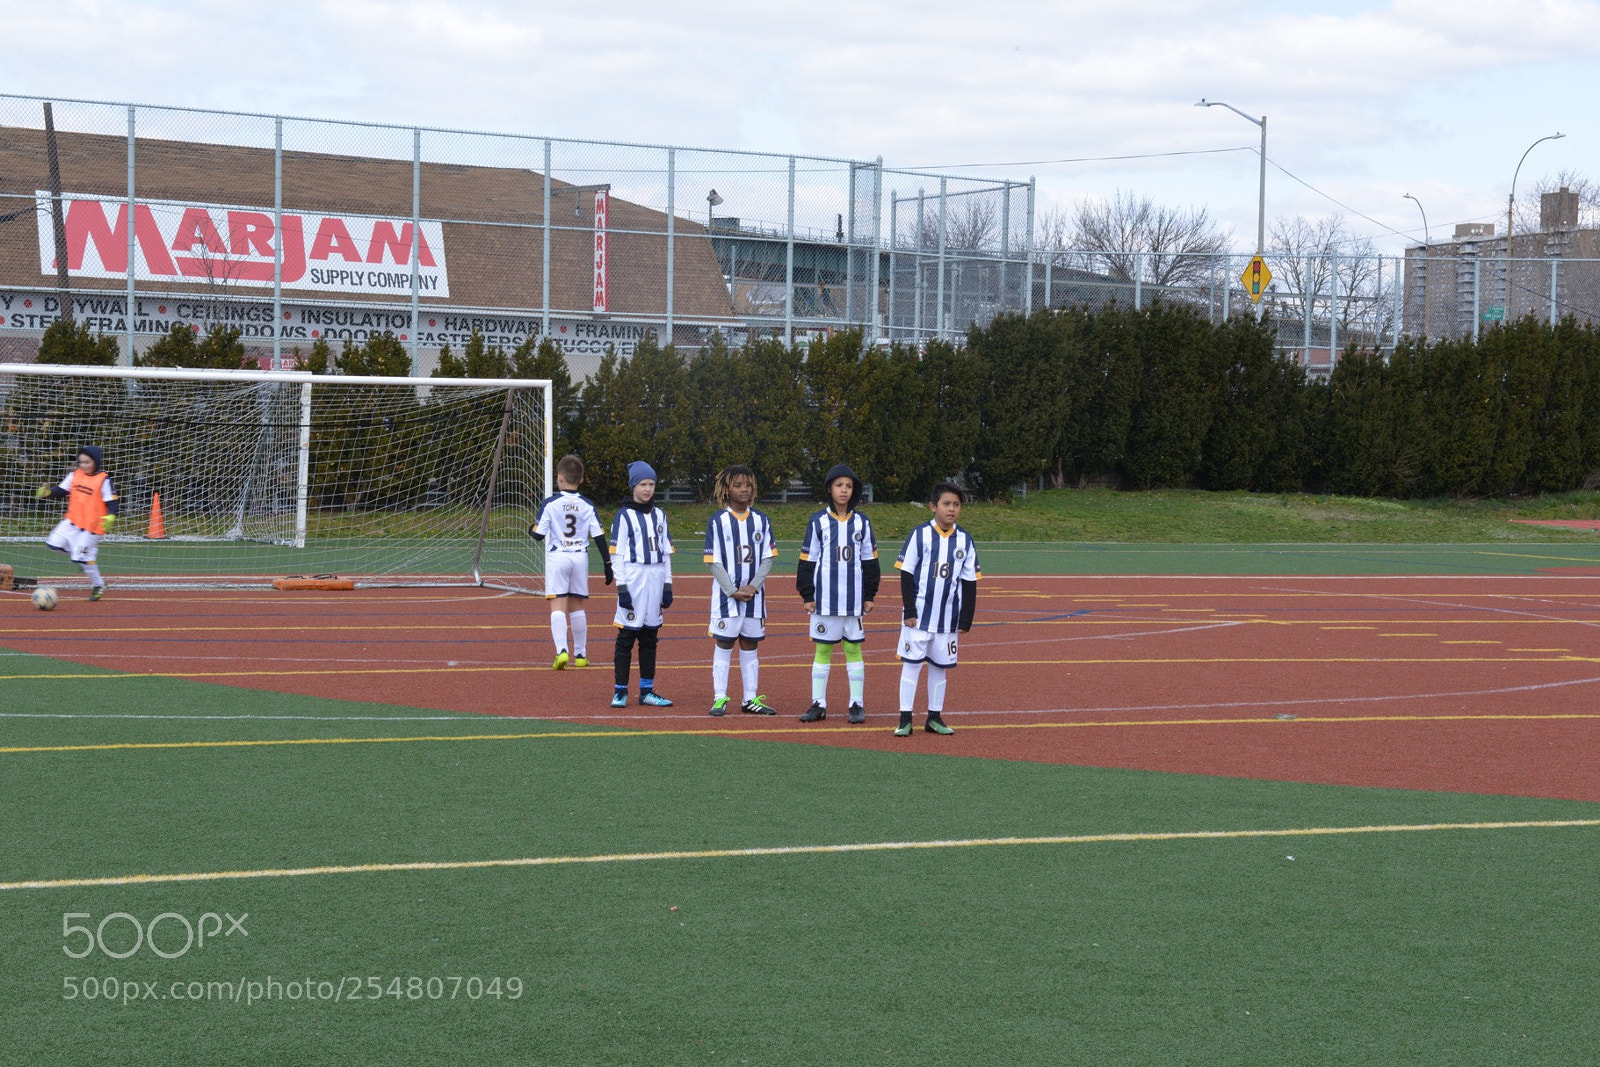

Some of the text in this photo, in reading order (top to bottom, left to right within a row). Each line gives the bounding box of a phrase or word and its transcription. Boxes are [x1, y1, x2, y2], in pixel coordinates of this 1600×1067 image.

[53, 199, 437, 283] MARJAM
[595, 198, 604, 307] MARJAM
[310, 268, 364, 286] SUPPLY
[44, 296, 150, 317] DYWALL
[176, 303, 275, 322] CEILINGS
[11, 313, 63, 328] STE
[417, 332, 523, 350] ASTEERS
[563, 514, 577, 538] 3
[648, 536, 658, 552] 11
[736, 544, 753, 565] 12
[836, 545, 853, 562] 10
[932, 562, 950, 579] 16
[947, 640, 957, 656] 16
